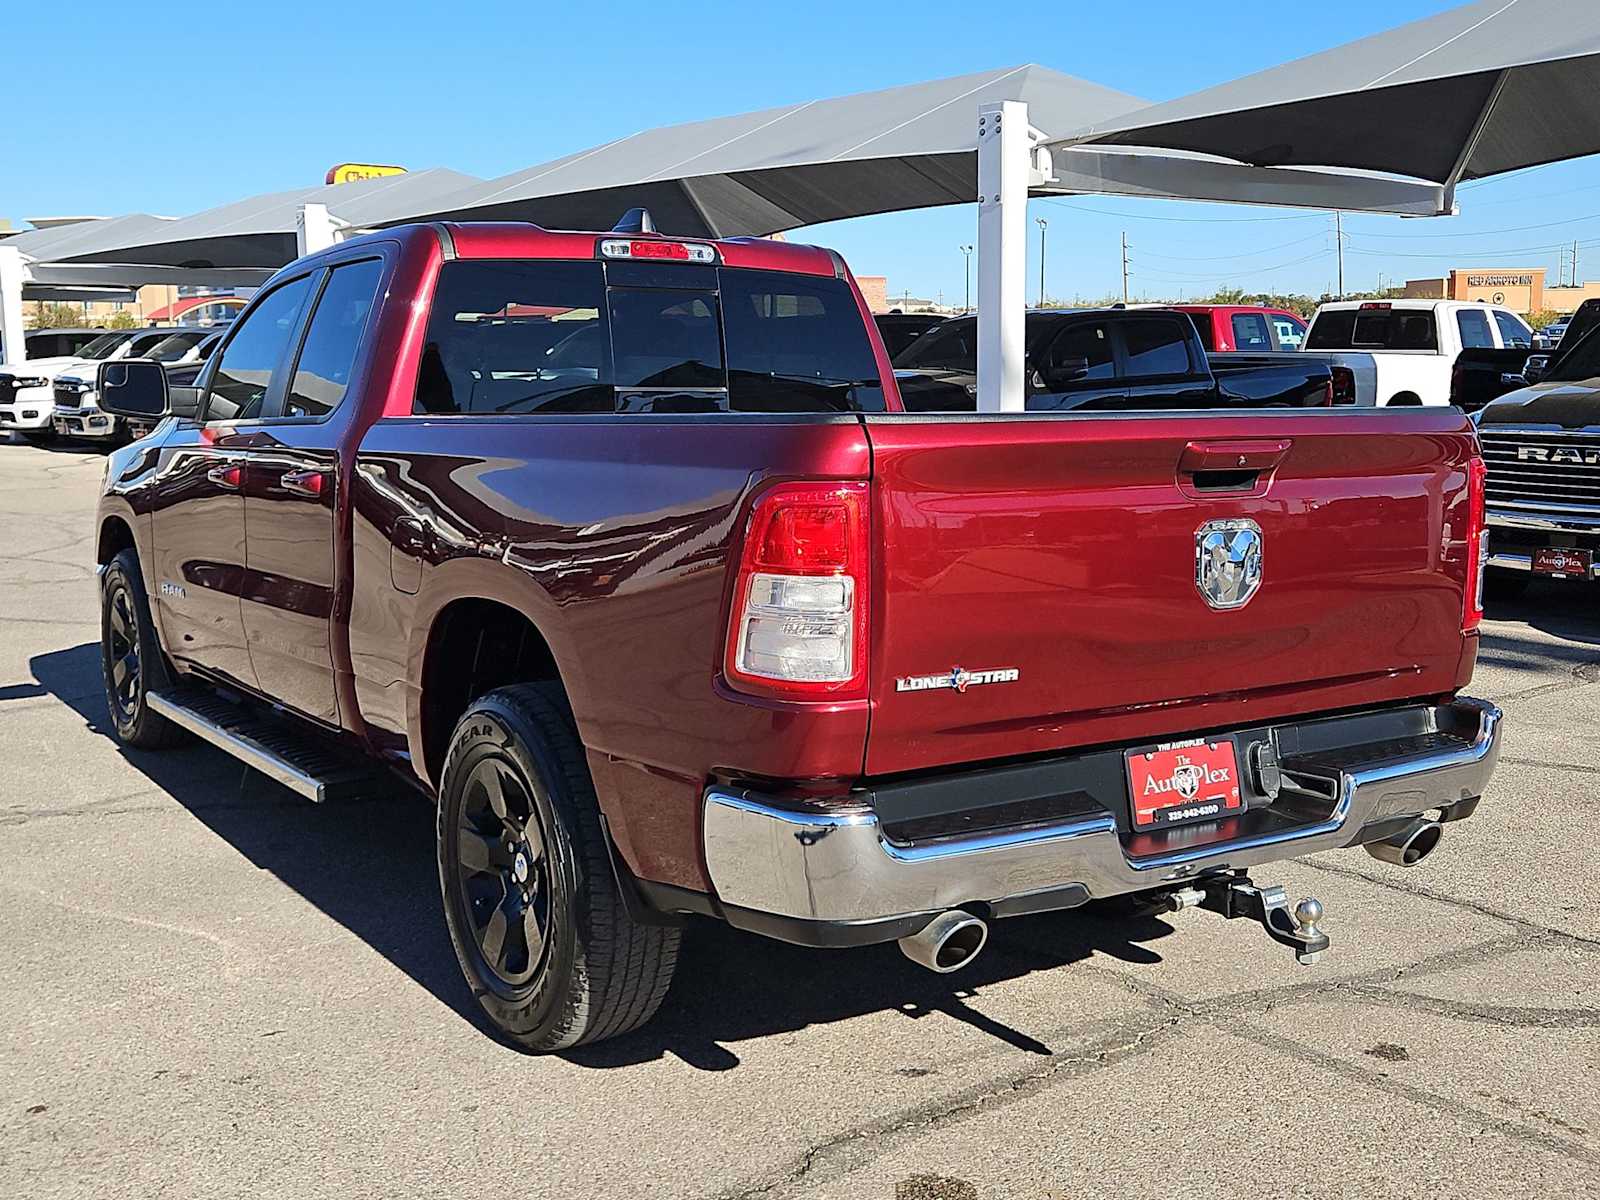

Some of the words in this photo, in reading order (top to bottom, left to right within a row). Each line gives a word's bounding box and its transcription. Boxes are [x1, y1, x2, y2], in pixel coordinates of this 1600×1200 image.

[1467, 275, 1484, 287] RED
[161, 583, 186, 600] RAM
[896, 675, 951, 692] LONE
[969, 668, 1020, 685] STAR
[1157, 742, 1171, 752] THE
[1171, 737, 1206, 750] AUTOPLEX
[1176, 754, 1192, 766] The
[1167, 804, 1219, 821] 325-942-6200
